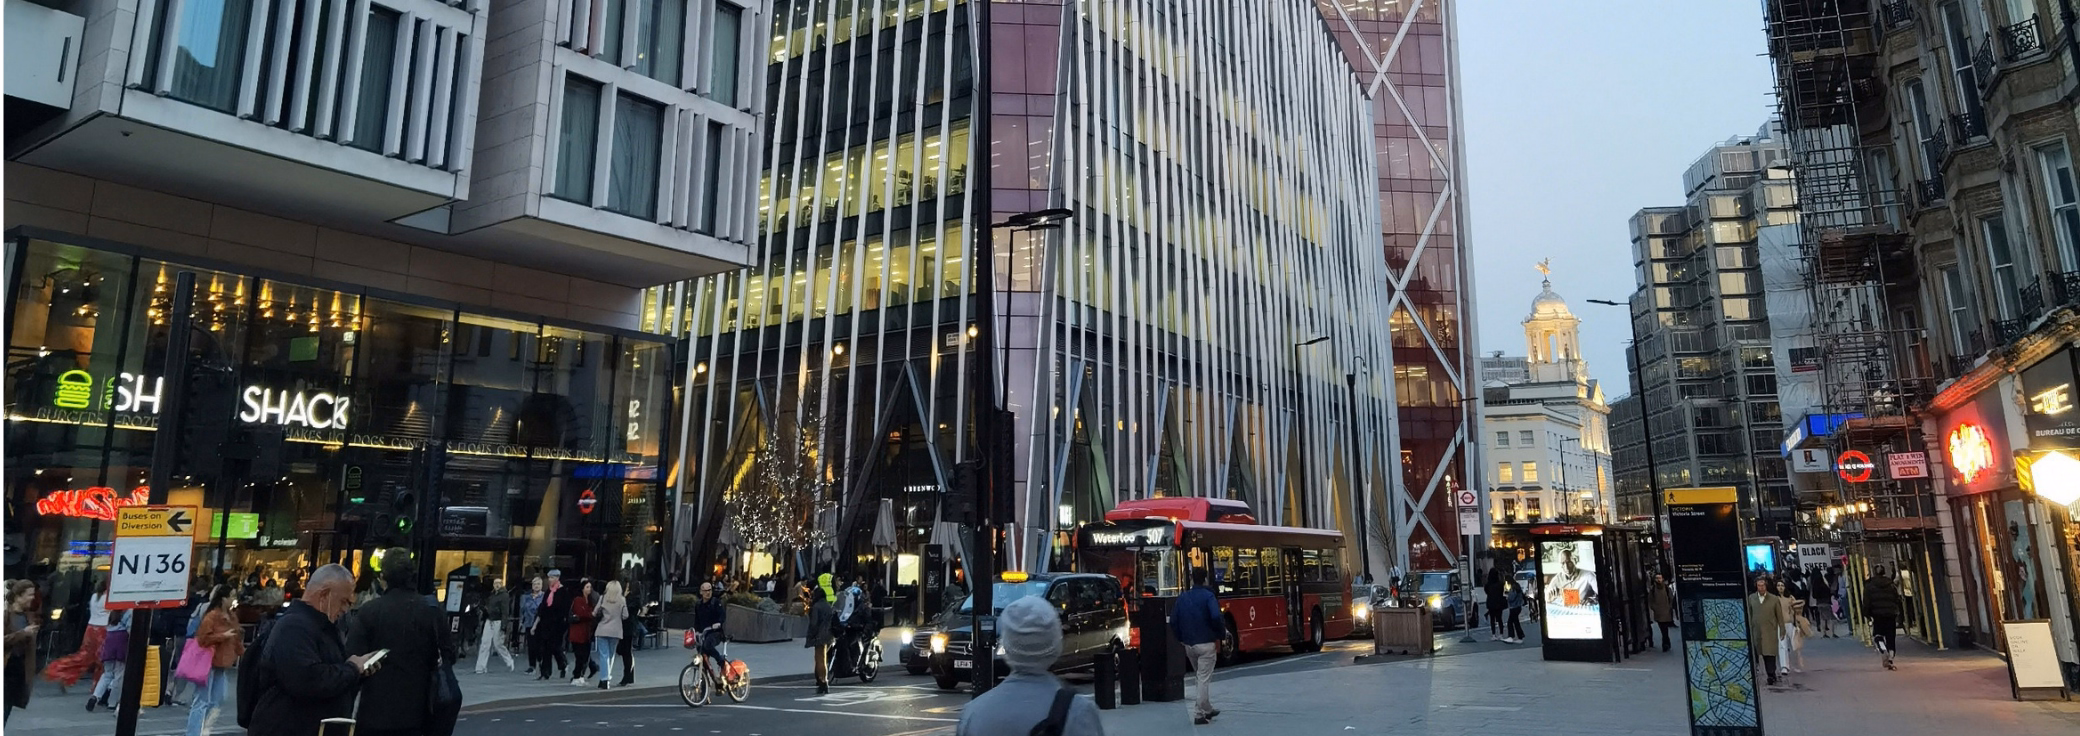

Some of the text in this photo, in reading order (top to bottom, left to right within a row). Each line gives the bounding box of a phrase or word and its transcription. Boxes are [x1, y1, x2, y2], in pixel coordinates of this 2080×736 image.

[240, 385, 350, 430] SHACK
[2036, 428, 2065, 437] BUREAU
[2066, 427, 2076, 435] DE
[353, 433, 385, 446] DOGS
[1900, 467, 1919, 475] ATM
[122, 512, 148, 520] Buses
[121, 522, 162, 530] Diversion
[1092, 528, 1164, 545] Waterloo 507
[1802, 547, 1827, 556] BLACK
[118, 553, 185, 575] N136
